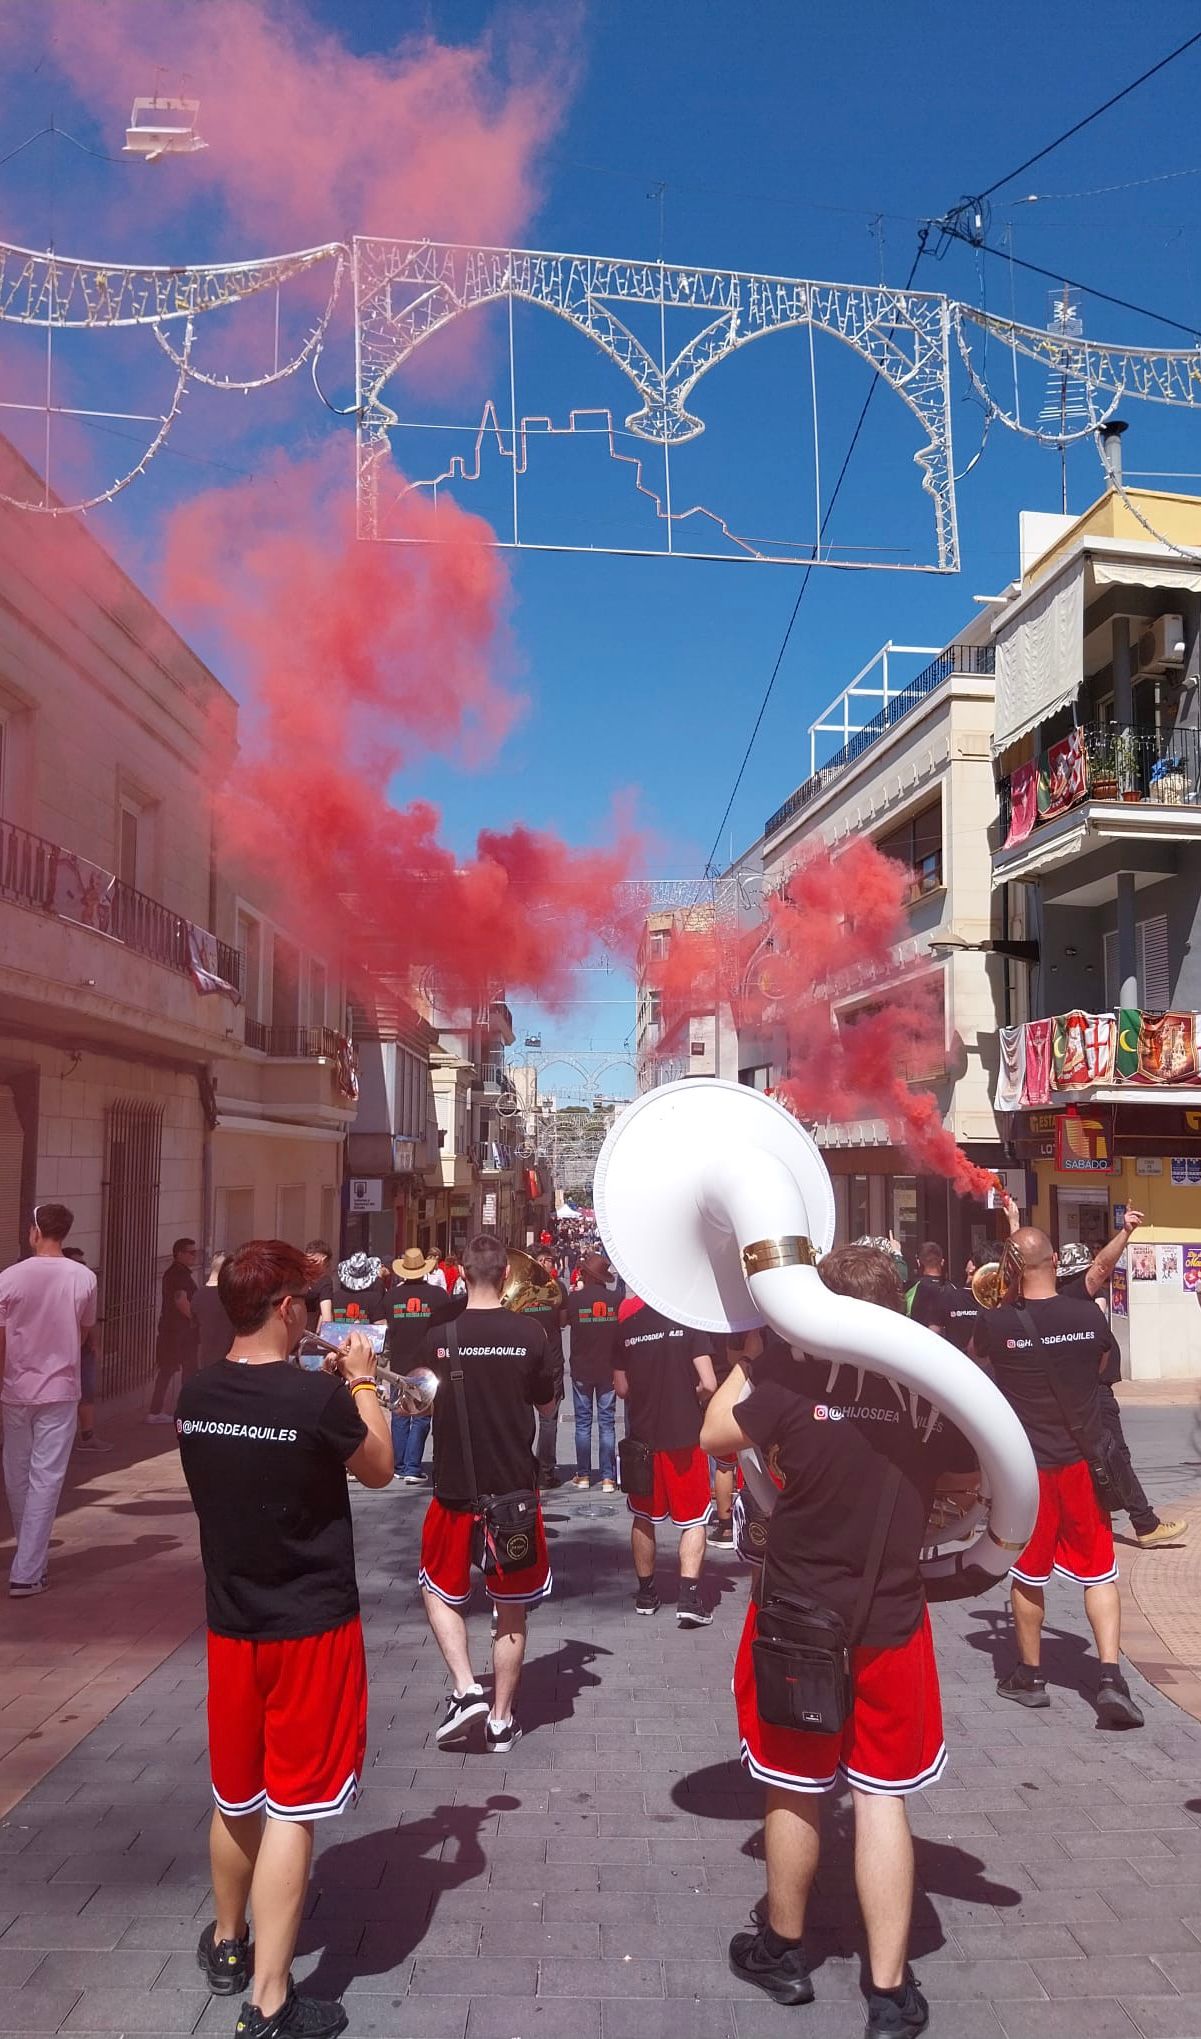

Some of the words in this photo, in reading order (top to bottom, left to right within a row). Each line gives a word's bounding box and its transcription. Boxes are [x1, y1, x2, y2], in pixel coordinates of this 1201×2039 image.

[1065, 1159, 1107, 1169] SABADO
[1016, 1331, 1095, 1349] @HSDEAQUILES
[445, 1346, 527, 1358] IJOSDEAQUILES
[182, 1419, 298, 1441] @HIJOSDEAQUILES
